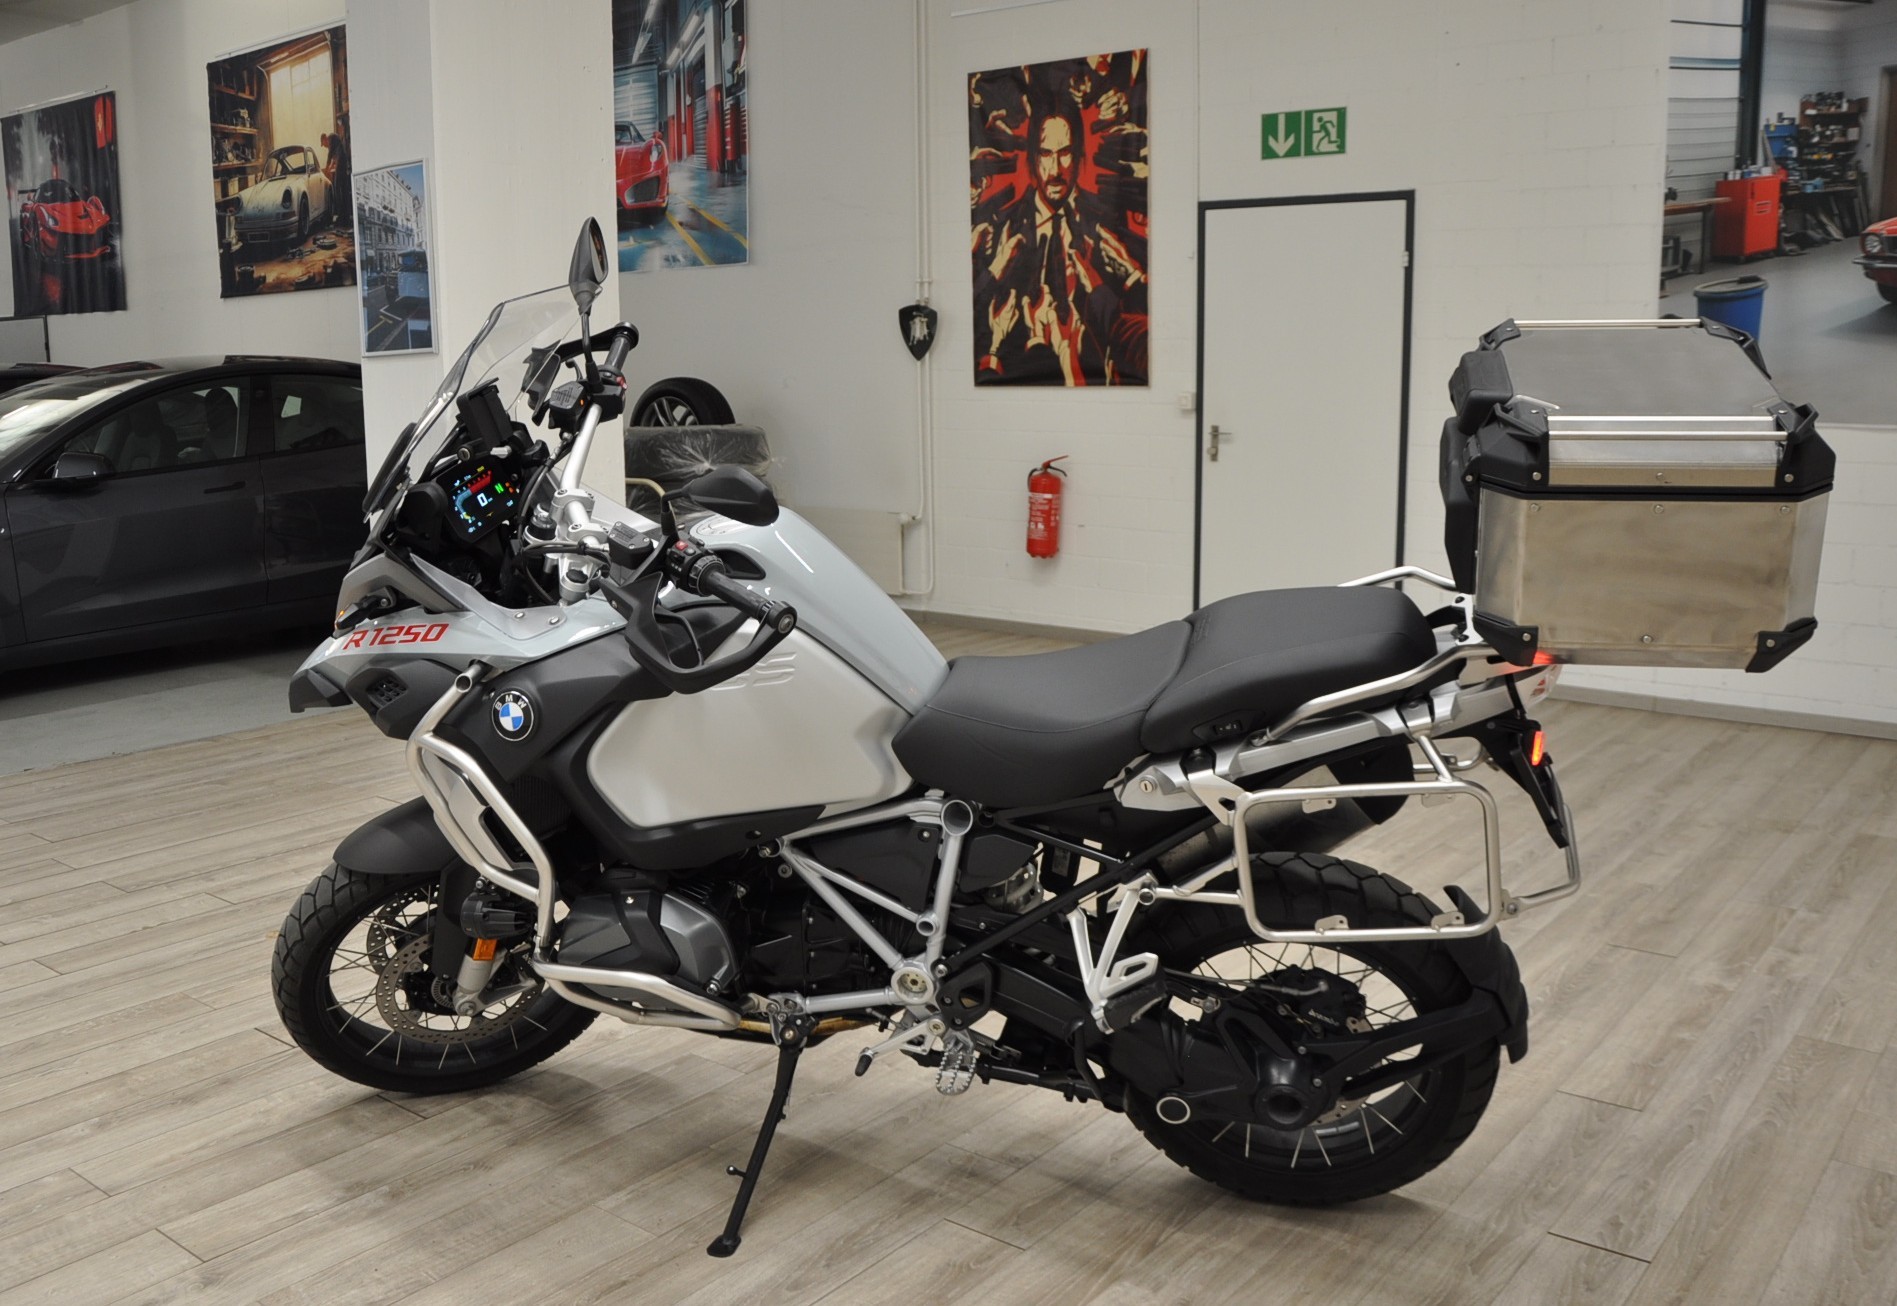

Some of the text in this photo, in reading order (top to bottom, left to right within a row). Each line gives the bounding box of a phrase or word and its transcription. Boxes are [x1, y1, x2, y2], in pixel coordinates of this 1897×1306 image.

[495, 483, 504, 493] N
[477, 493, 488, 507] 0
[494, 694, 528, 711] BMW
